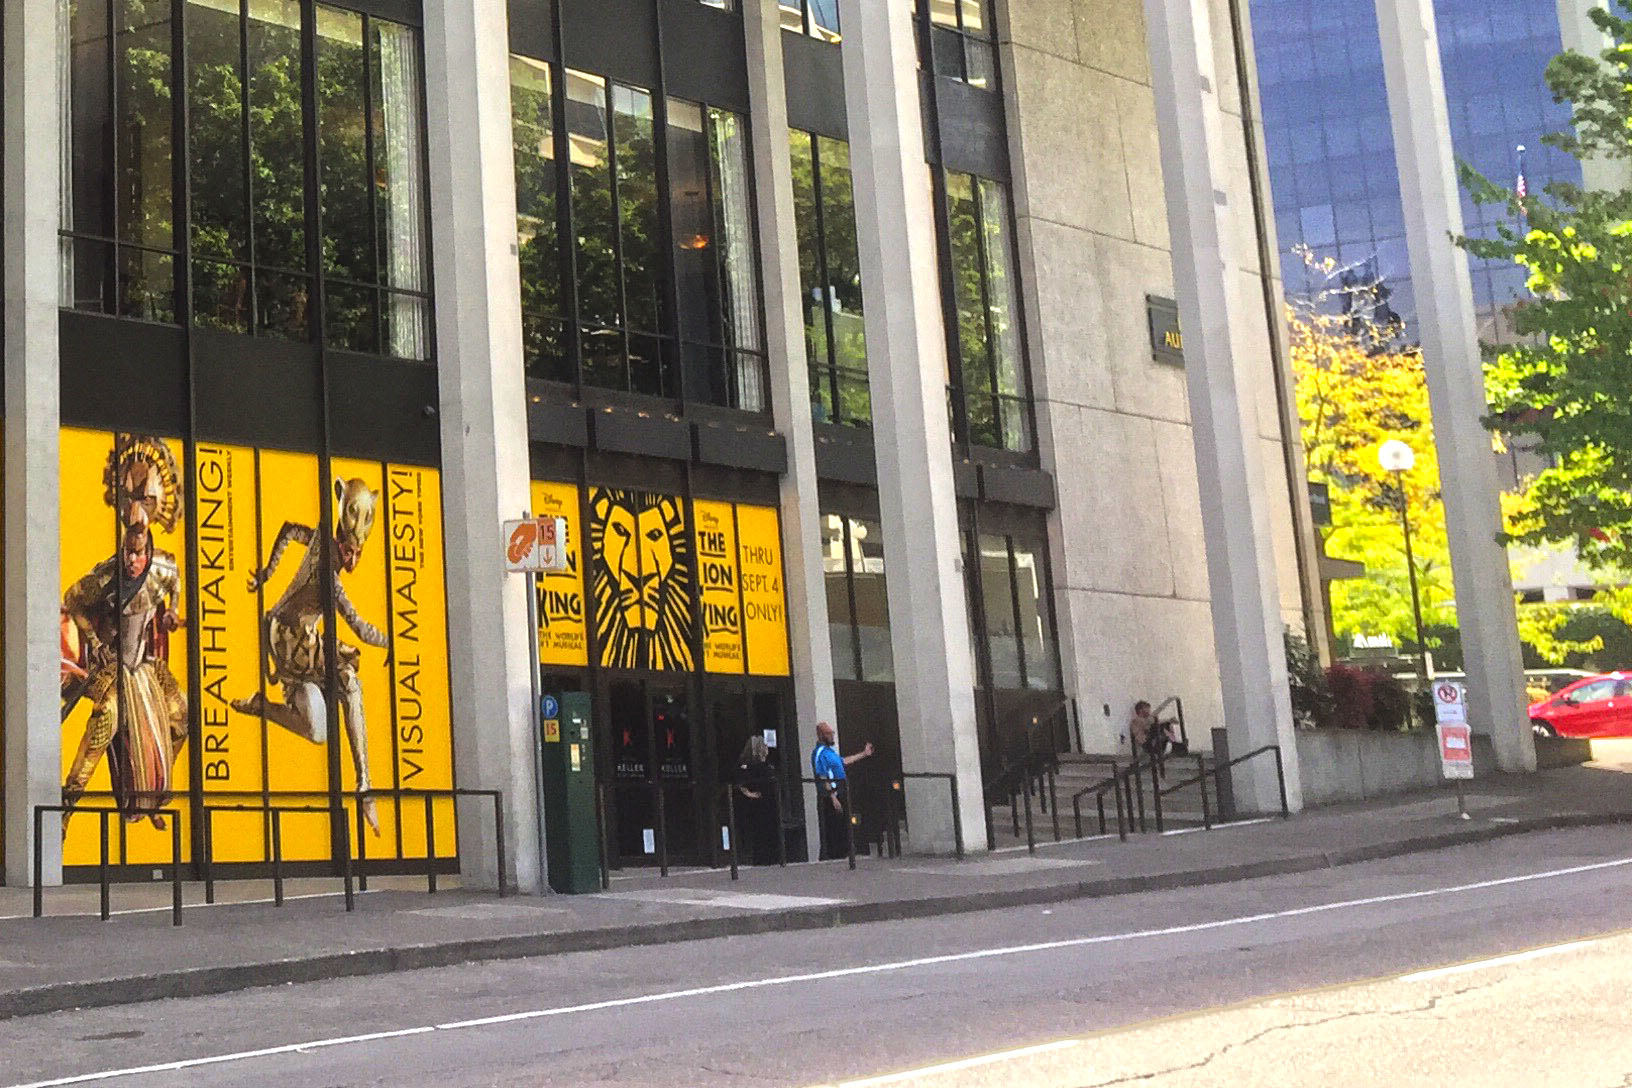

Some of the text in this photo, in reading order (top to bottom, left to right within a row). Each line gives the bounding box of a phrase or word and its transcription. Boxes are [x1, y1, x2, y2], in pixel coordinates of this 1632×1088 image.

[540, 524, 555, 540] 15
[698, 531, 726, 554] THE
[742, 545, 773, 565] THRU
[700, 562, 733, 594] ION
[742, 573, 779, 594] SEPT. 4
[199, 447, 230, 782] BREATHTAKING!
[745, 602, 782, 623] ONLY!
[391, 469, 424, 782] VISUAL MAJESTY!
[545, 721, 557, 735] 15
